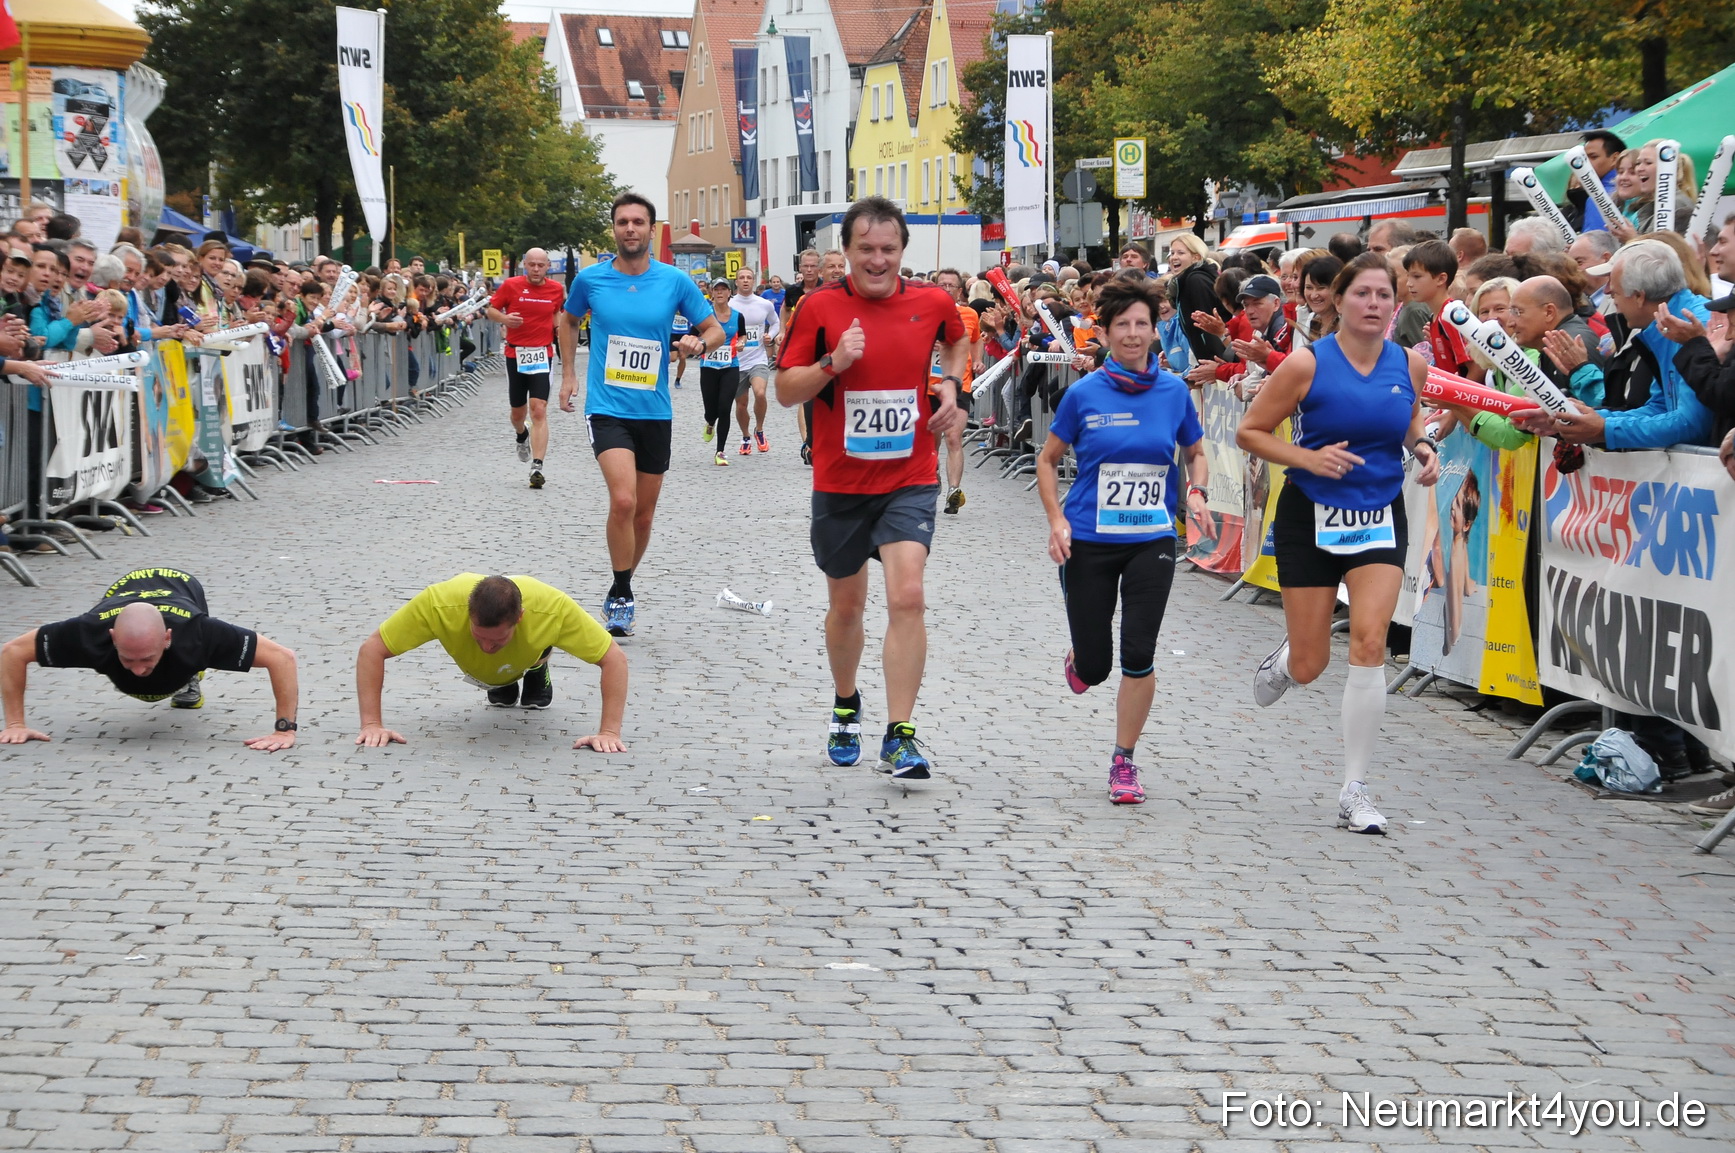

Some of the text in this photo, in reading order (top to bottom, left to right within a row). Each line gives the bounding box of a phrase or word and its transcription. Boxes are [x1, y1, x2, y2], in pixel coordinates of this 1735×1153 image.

[879, 141, 894, 158] HOTEL
[1657, 173, 1673, 232] bmw-lau
[1534, 191, 1575, 246] bmw-laufspo
[488, 258, 497, 271] D
[730, 260, 739, 272] D
[629, 342, 654, 350] Neumarkt
[520, 351, 545, 364] 2349
[619, 349, 650, 370] 100
[707, 351, 729, 361] 2416
[1044, 353, 1062, 362] BMW
[46, 371, 132, 385] mw-laufsport.de
[616, 371, 647, 383] Bernhard
[1504, 350, 1573, 425] BMW Laufs
[872, 397, 905, 405] Neumarkt
[1454, 389, 1512, 411] Audi BKK
[853, 407, 912, 433] 2402
[875, 440, 892, 450] Jan
[1101, 469, 1157, 478] PARTL Neumarkt
[1106, 481, 1160, 506] 2739
[1118, 513, 1153, 525] Brigitte
[1561, 472, 1719, 581] INTERSPORT
[1338, 533, 1371, 544] Andrea
